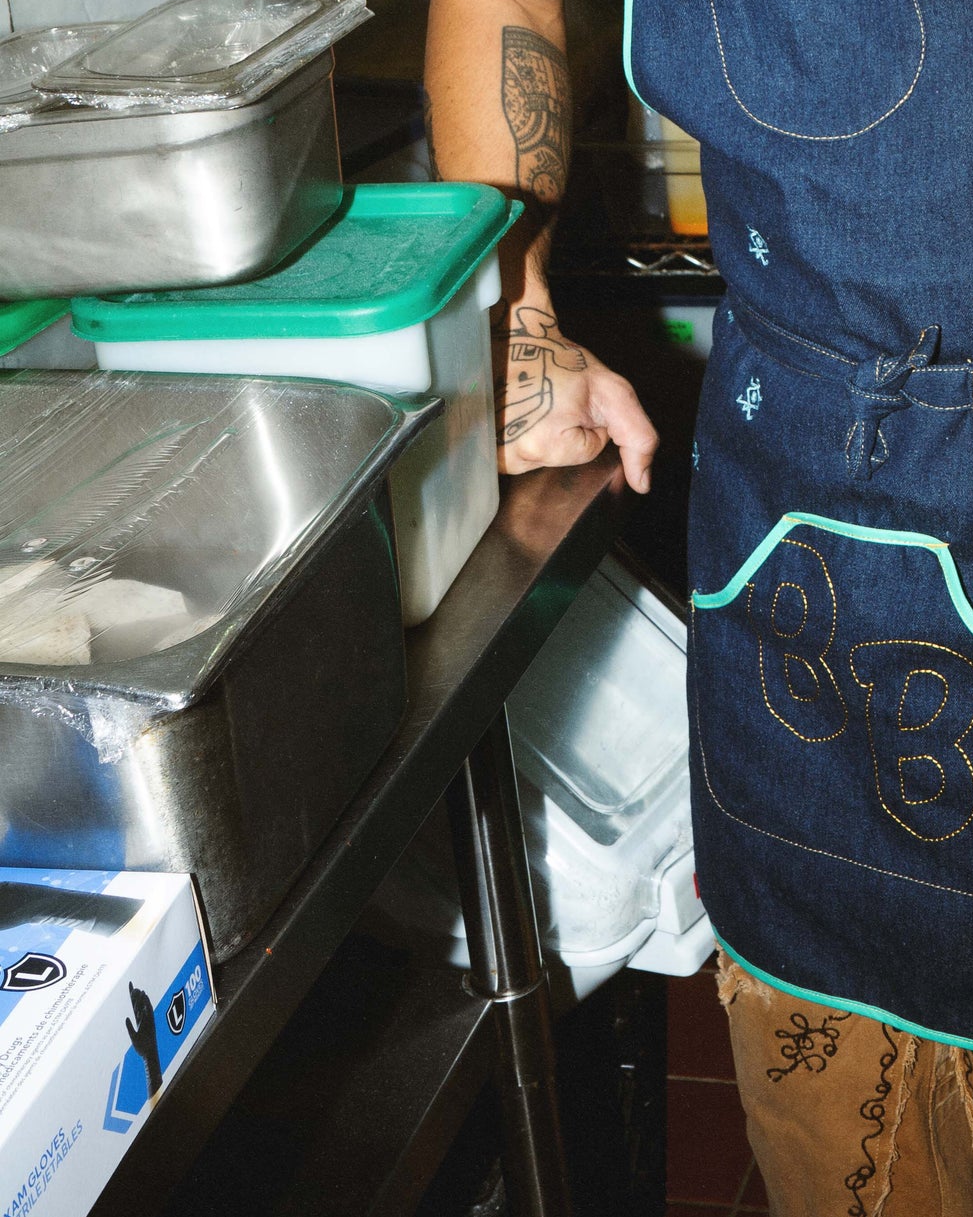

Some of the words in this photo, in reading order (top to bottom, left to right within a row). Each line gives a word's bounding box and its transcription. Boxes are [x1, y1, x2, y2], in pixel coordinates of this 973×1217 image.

[184, 964, 202, 997] 100
[35, 1020, 48, 1031] de
[0, 1036, 23, 1061] Drugs
[28, 1127, 65, 1188] GLOVES
[42, 1119, 83, 1192] JETABLES
